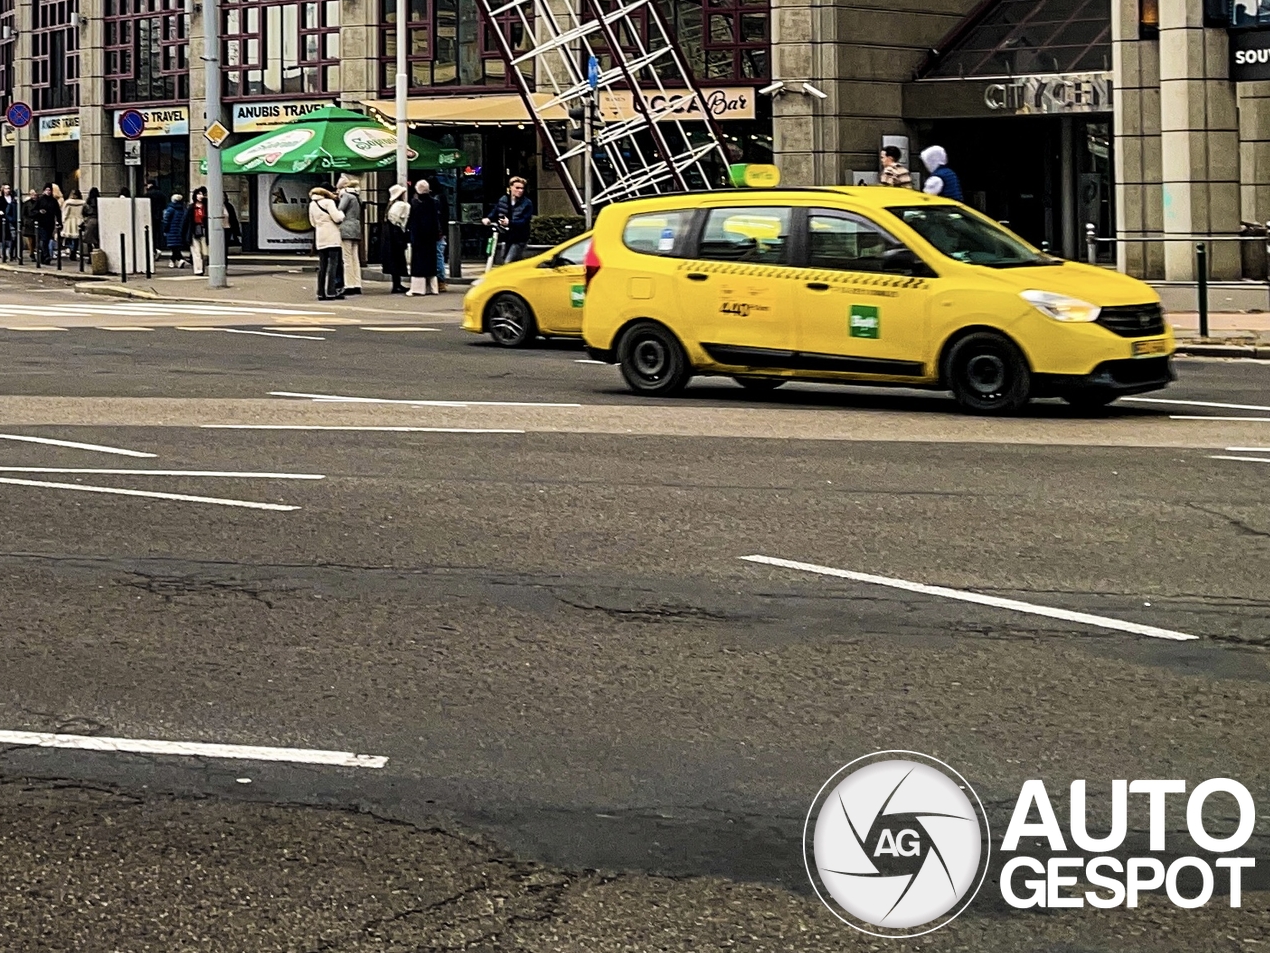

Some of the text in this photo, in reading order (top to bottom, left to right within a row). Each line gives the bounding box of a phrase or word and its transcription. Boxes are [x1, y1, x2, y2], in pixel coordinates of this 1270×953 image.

[1235, 48, 1270, 64] SOU
[706, 90, 747, 115] Bar
[151, 110, 185, 123] TRAVEL
[238, 105, 280, 118] ANUBIS
